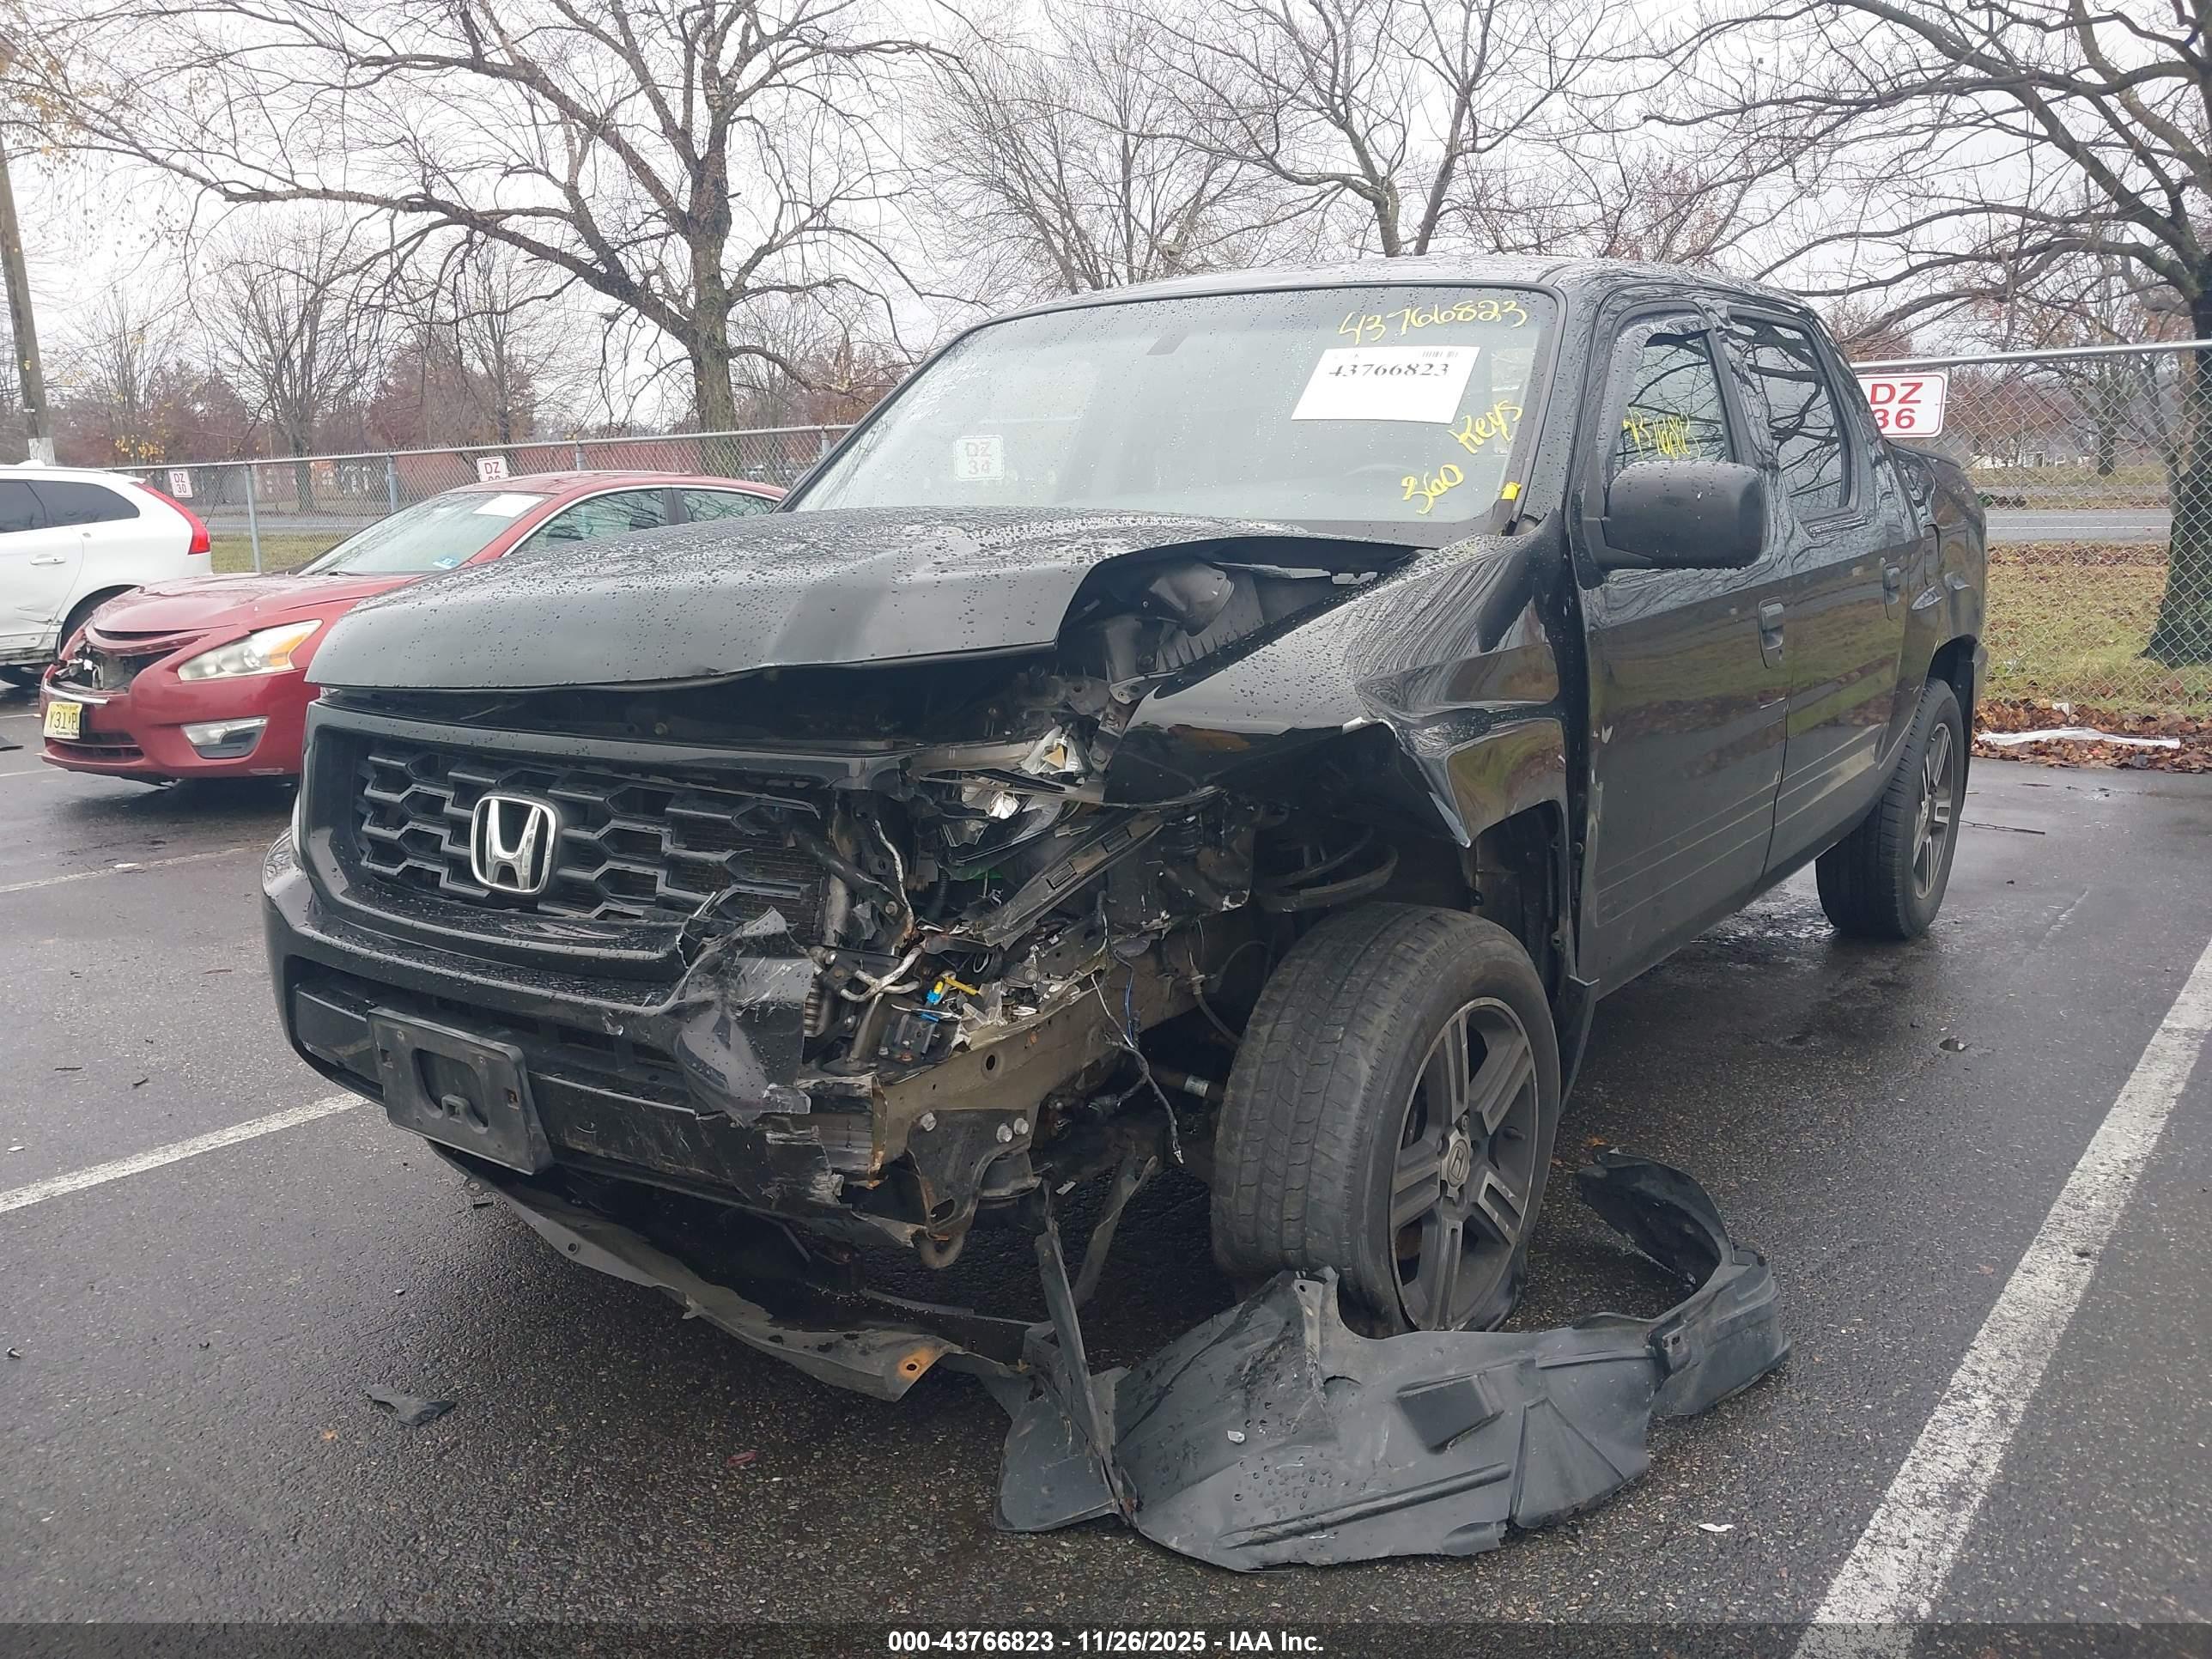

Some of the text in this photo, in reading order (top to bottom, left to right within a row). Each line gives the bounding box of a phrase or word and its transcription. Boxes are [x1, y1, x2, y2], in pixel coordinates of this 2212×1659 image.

[1339, 300, 1528, 345] 43766823
[1328, 363, 1449, 377] 43766823
[1869, 382, 1923, 404] DZ
[1872, 408, 1917, 429] 36
[965, 441, 992, 458] DZ
[484, 462, 502, 474] DZ
[173, 473, 185, 483] DZ
[177, 483, 186, 493] 30
[1401, 464, 1464, 514] 360
